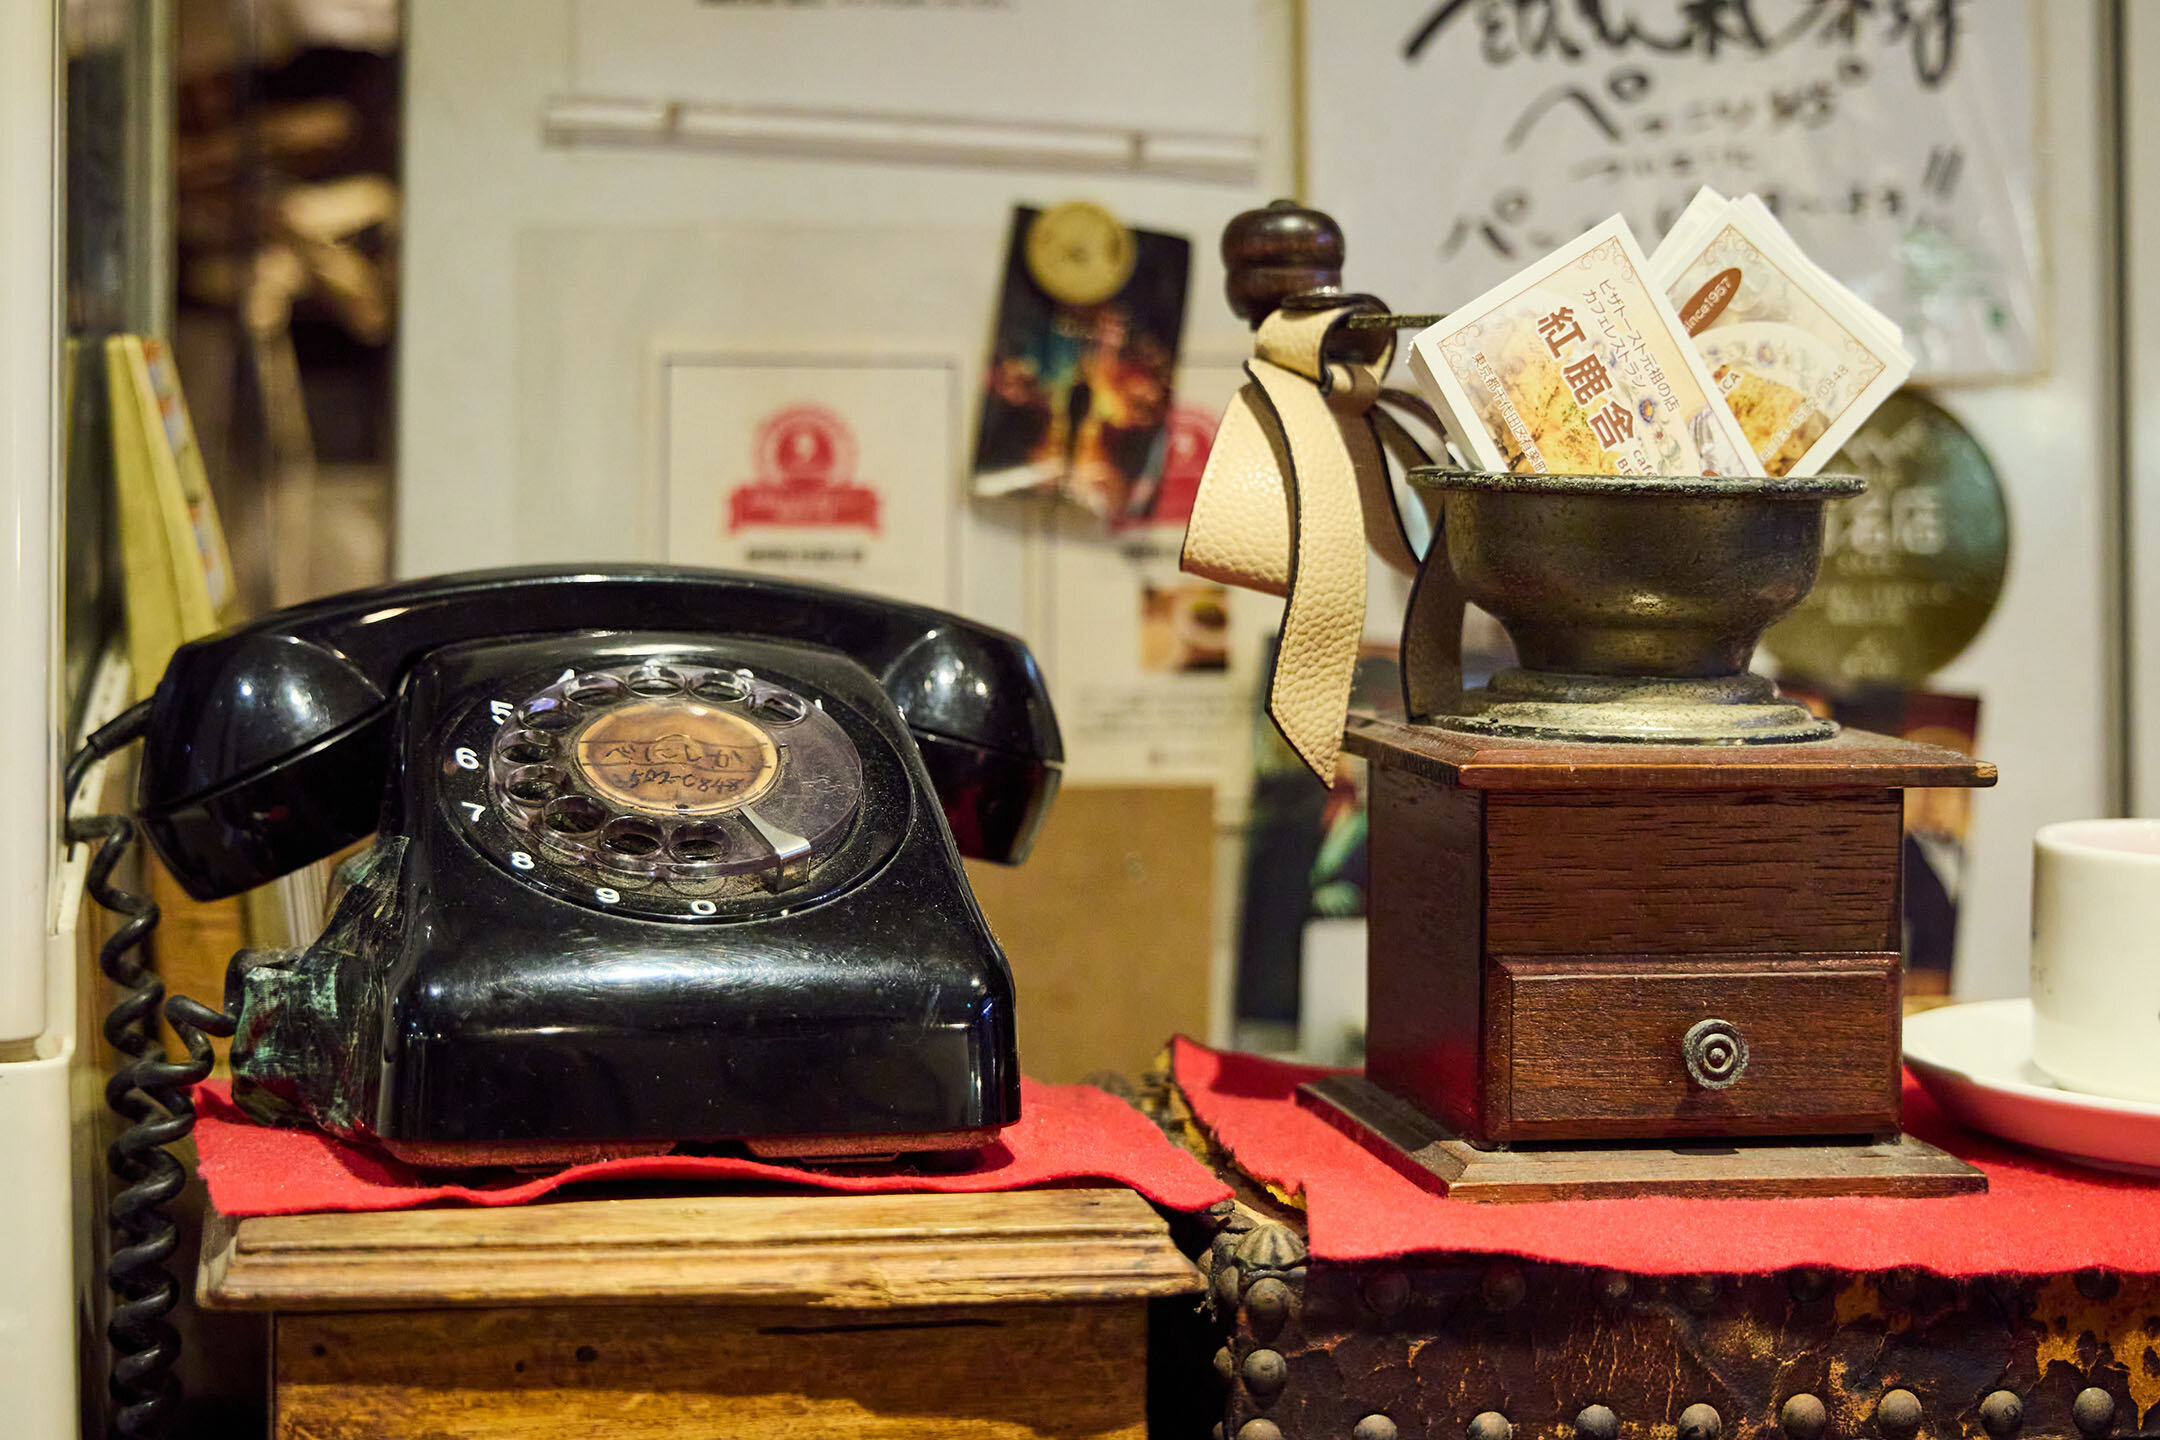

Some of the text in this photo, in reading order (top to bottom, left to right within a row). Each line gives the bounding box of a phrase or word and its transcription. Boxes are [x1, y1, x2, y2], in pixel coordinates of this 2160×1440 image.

[1582, 289, 1646, 388] カフェレストラン
[1599, 279, 1680, 413] ピザトースト元祖の店
[490, 700, 514, 725] 5
[455, 747, 480, 770] 6
[461, 801, 486, 822] 7
[510, 851, 535, 870] 8
[595, 887, 621, 904] 9
[690, 899, 718, 916] 0
